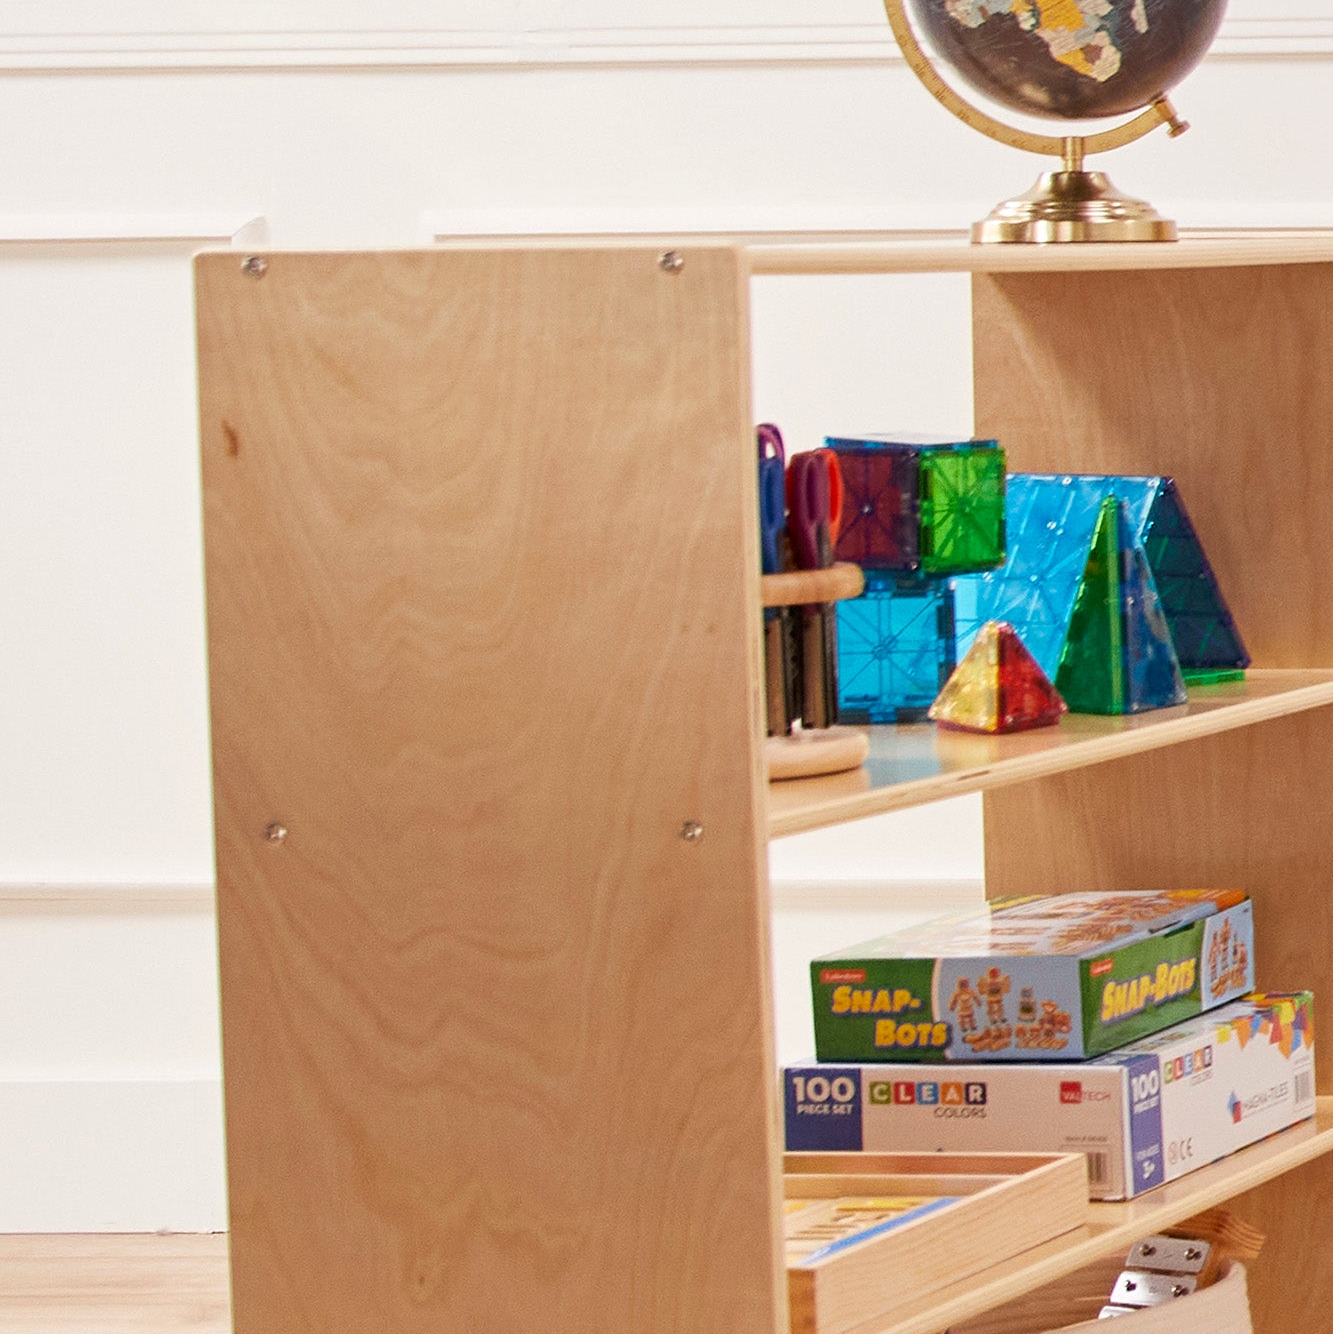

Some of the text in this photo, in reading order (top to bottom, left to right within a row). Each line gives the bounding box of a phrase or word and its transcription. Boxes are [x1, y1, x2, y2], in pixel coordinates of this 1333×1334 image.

[1102, 959, 1195, 1022] SNAP-BOTS
[874, 1020, 947, 1046] BOTS
[1165, 1045, 1212, 1084] CLEAR
[792, 1077, 854, 1102] 100
[871, 1083, 986, 1103] CLEAR
[1132, 1070, 1158, 1103] 100
[797, 1105, 854, 1115] PIECE SET
[934, 1107, 986, 1118] COLORS
